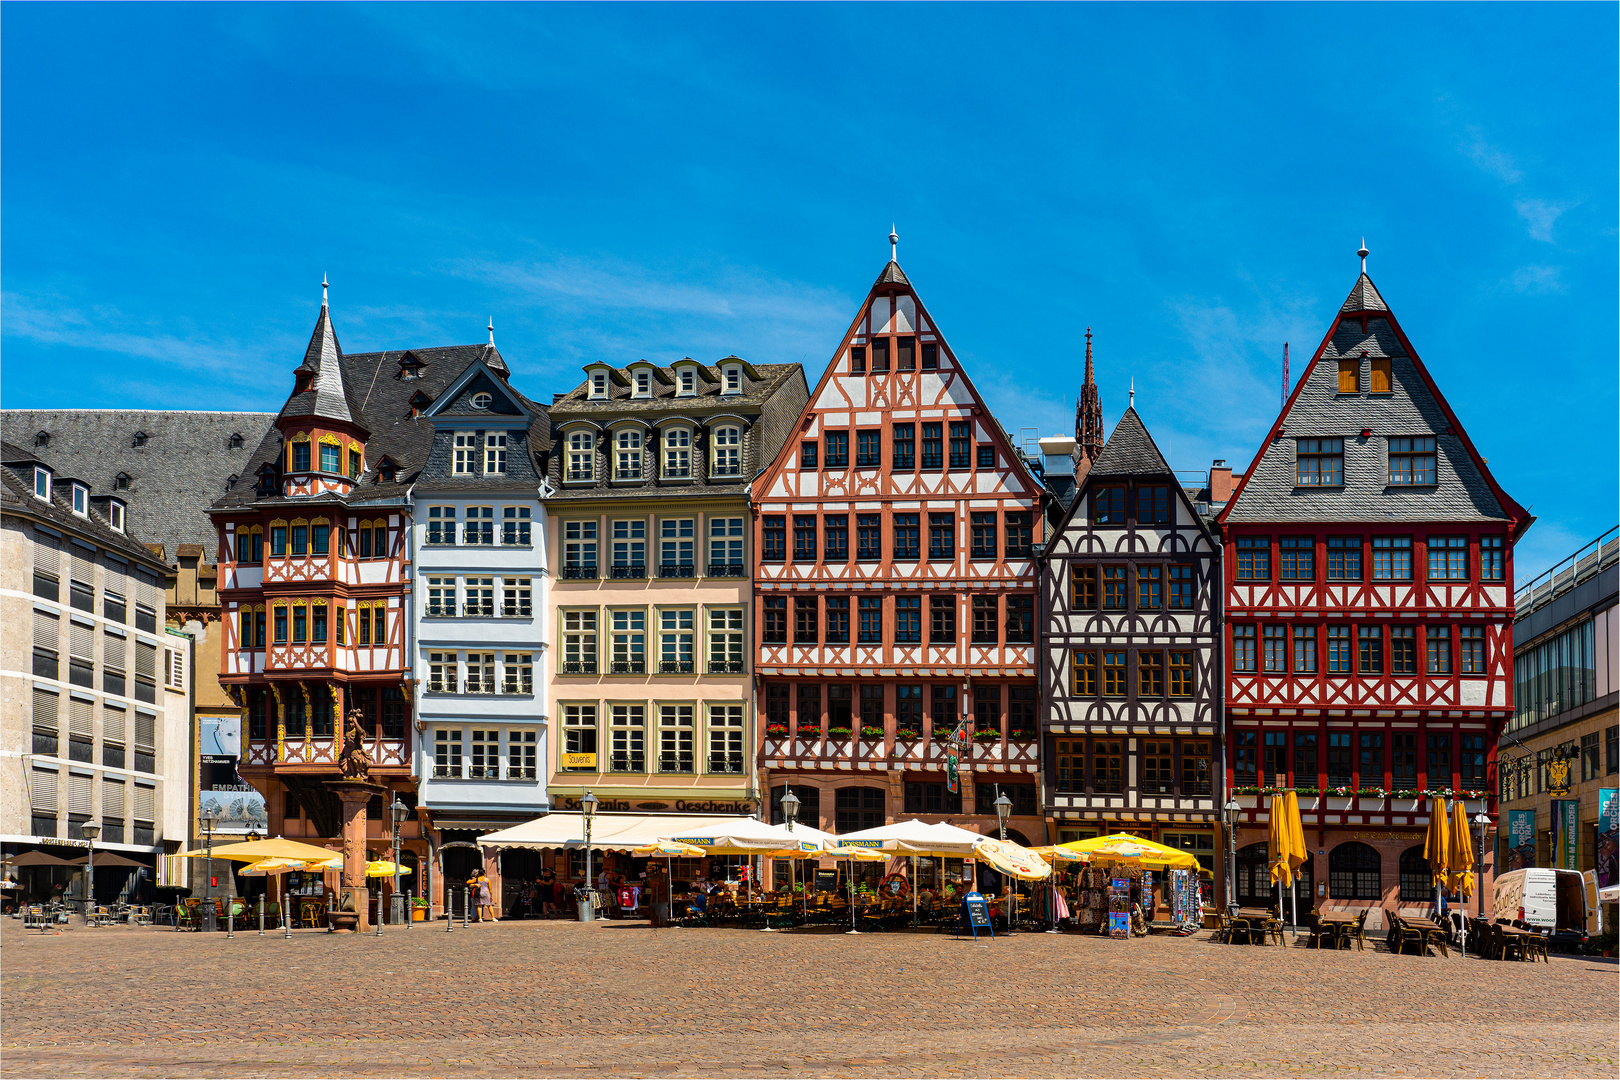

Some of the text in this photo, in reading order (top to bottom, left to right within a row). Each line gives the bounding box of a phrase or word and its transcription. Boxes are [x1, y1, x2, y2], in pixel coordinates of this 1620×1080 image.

[568, 754, 591, 764] Souvenirs
[212, 784, 255, 792] EMPATHI
[223, 792, 263, 800] SYSTEM
[564, 798, 631, 811] Soenirs
[675, 800, 751, 813] Geschenke
[1603, 800, 1611, 817] BIG
[1610, 792, 1619, 831] ORCHES
[1518, 813, 1526, 846] ORCHES
[1568, 803, 1576, 845] ARMLEDER
